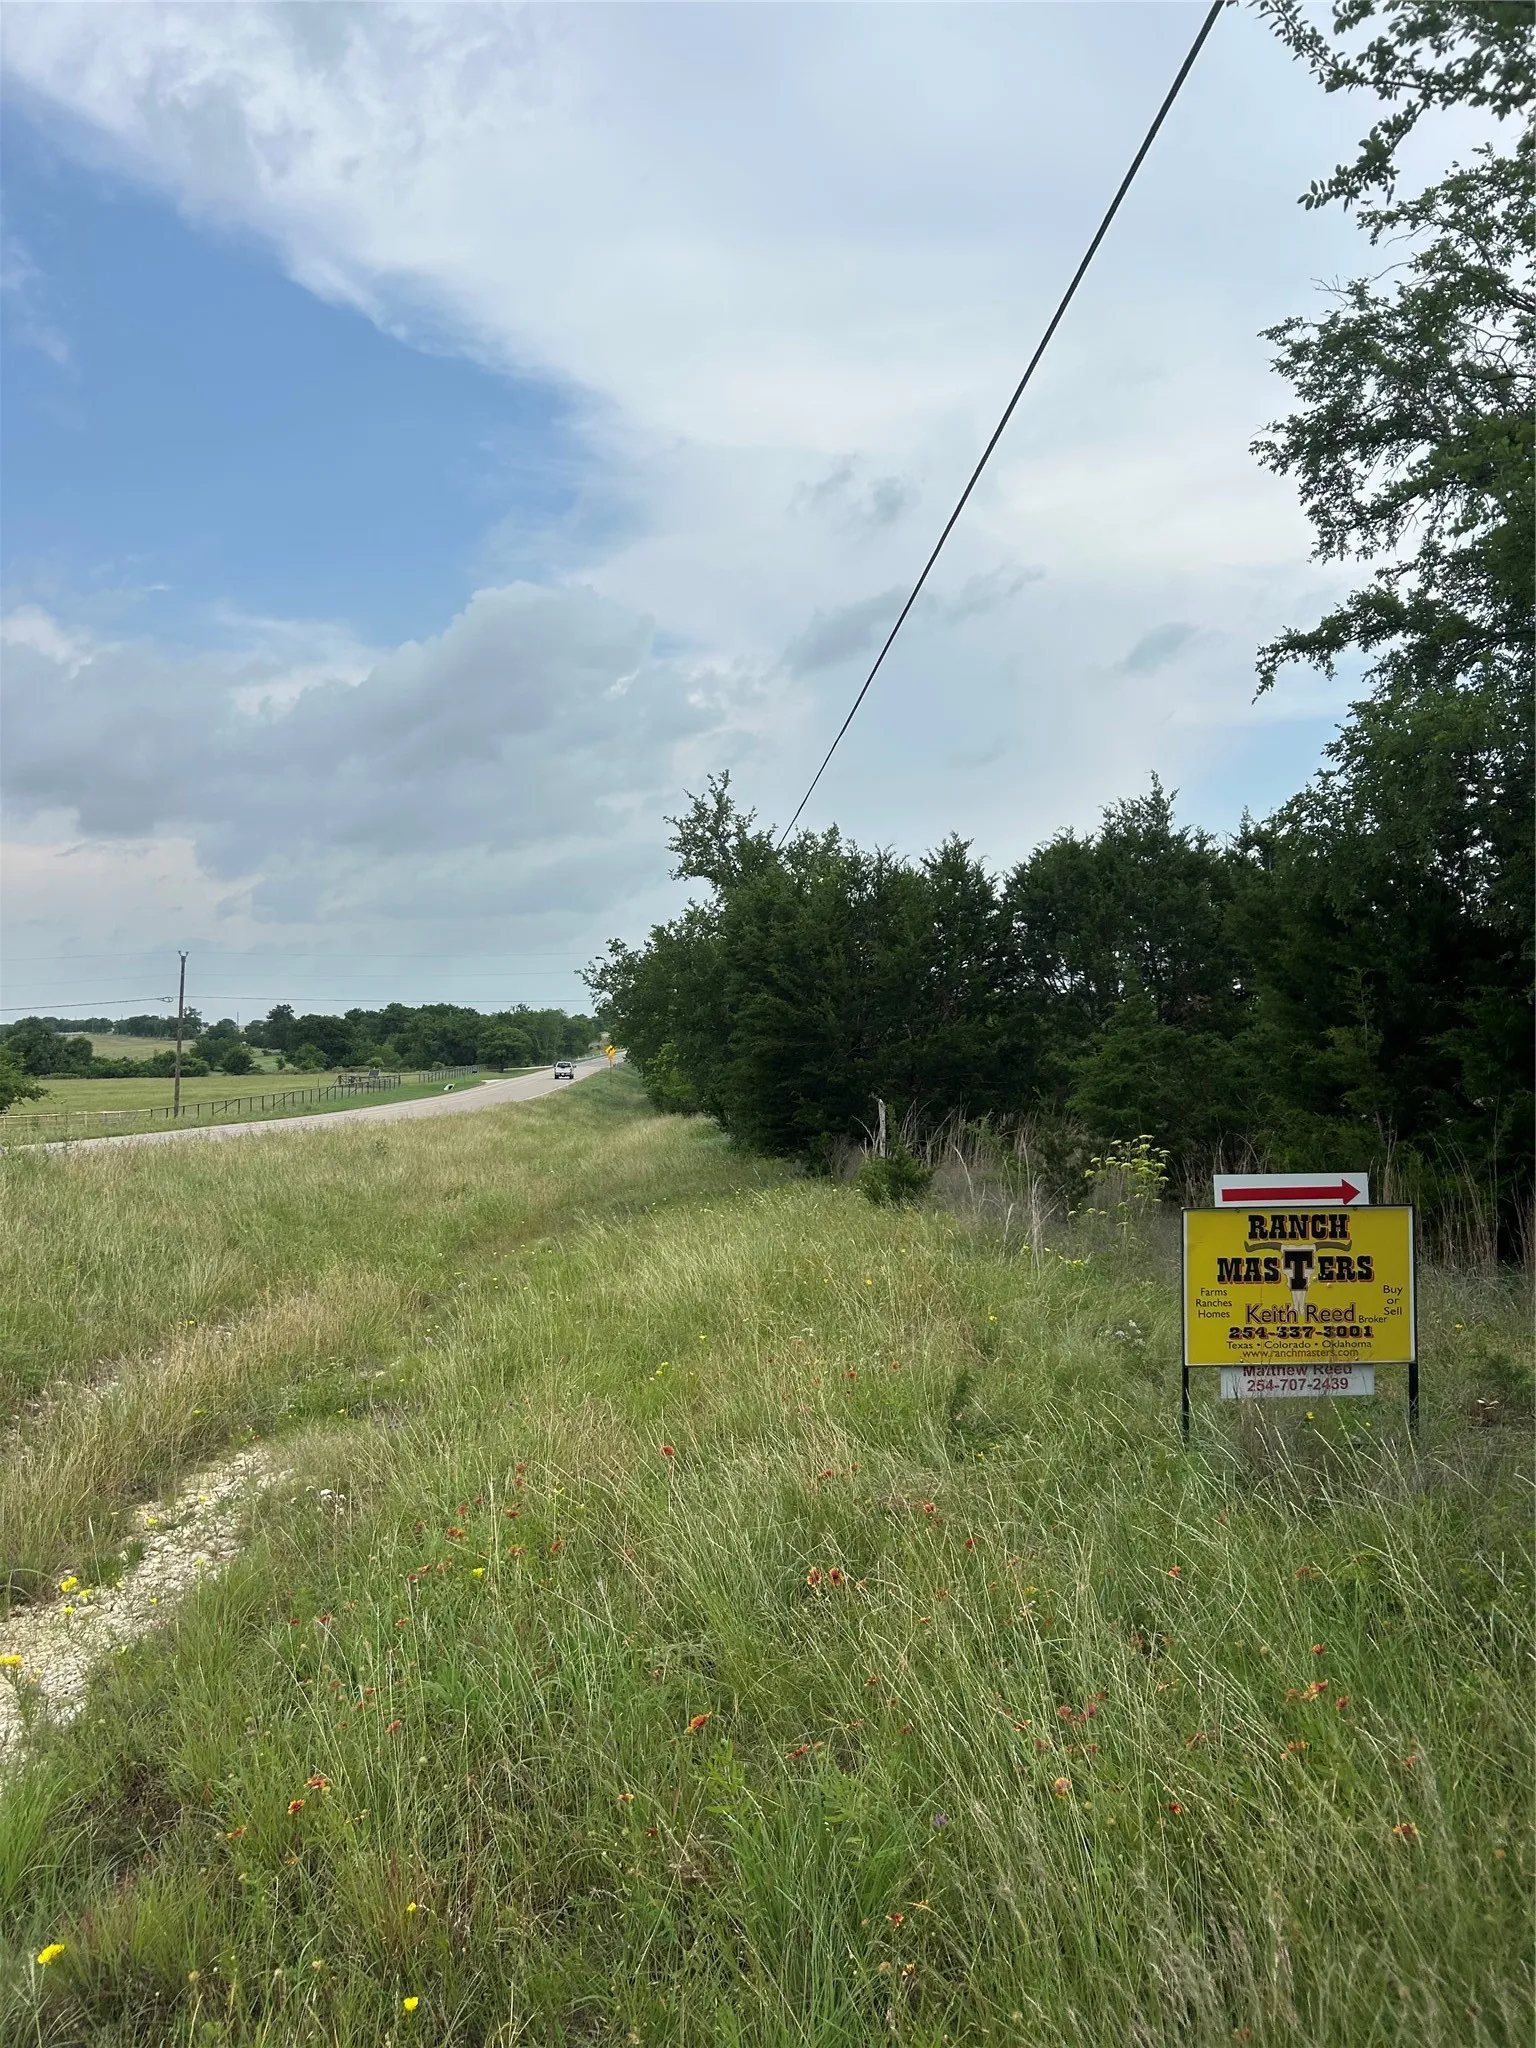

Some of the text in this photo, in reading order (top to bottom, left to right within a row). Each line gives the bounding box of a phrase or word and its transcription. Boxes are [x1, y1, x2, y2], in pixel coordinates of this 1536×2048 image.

[1248, 1214, 1351, 1240] RANCH
[1217, 1250, 1374, 1290] MASTERS
[1200, 1287, 1228, 1297] Farms
[1383, 1285, 1403, 1296] Buy
[1195, 1298, 1232, 1307] Ranches
[1387, 1297, 1400, 1305] or
[1198, 1309, 1230, 1318] Homes
[1245, 1302, 1356, 1324] Keith Reed
[1383, 1306, 1402, 1316] Sell
[1358, 1315, 1387, 1323] Broker
[1228, 1325, 1373, 1340] 254-337-3001
[1226, 1340, 1372, 1349] Texas Colorado Oklahoma
[1242, 1348, 1359, 1358] www.ranchmasters.com
[1313, 1364, 1352, 1376] Reed
[1247, 1377, 1349, 1392] 254-707-2439
